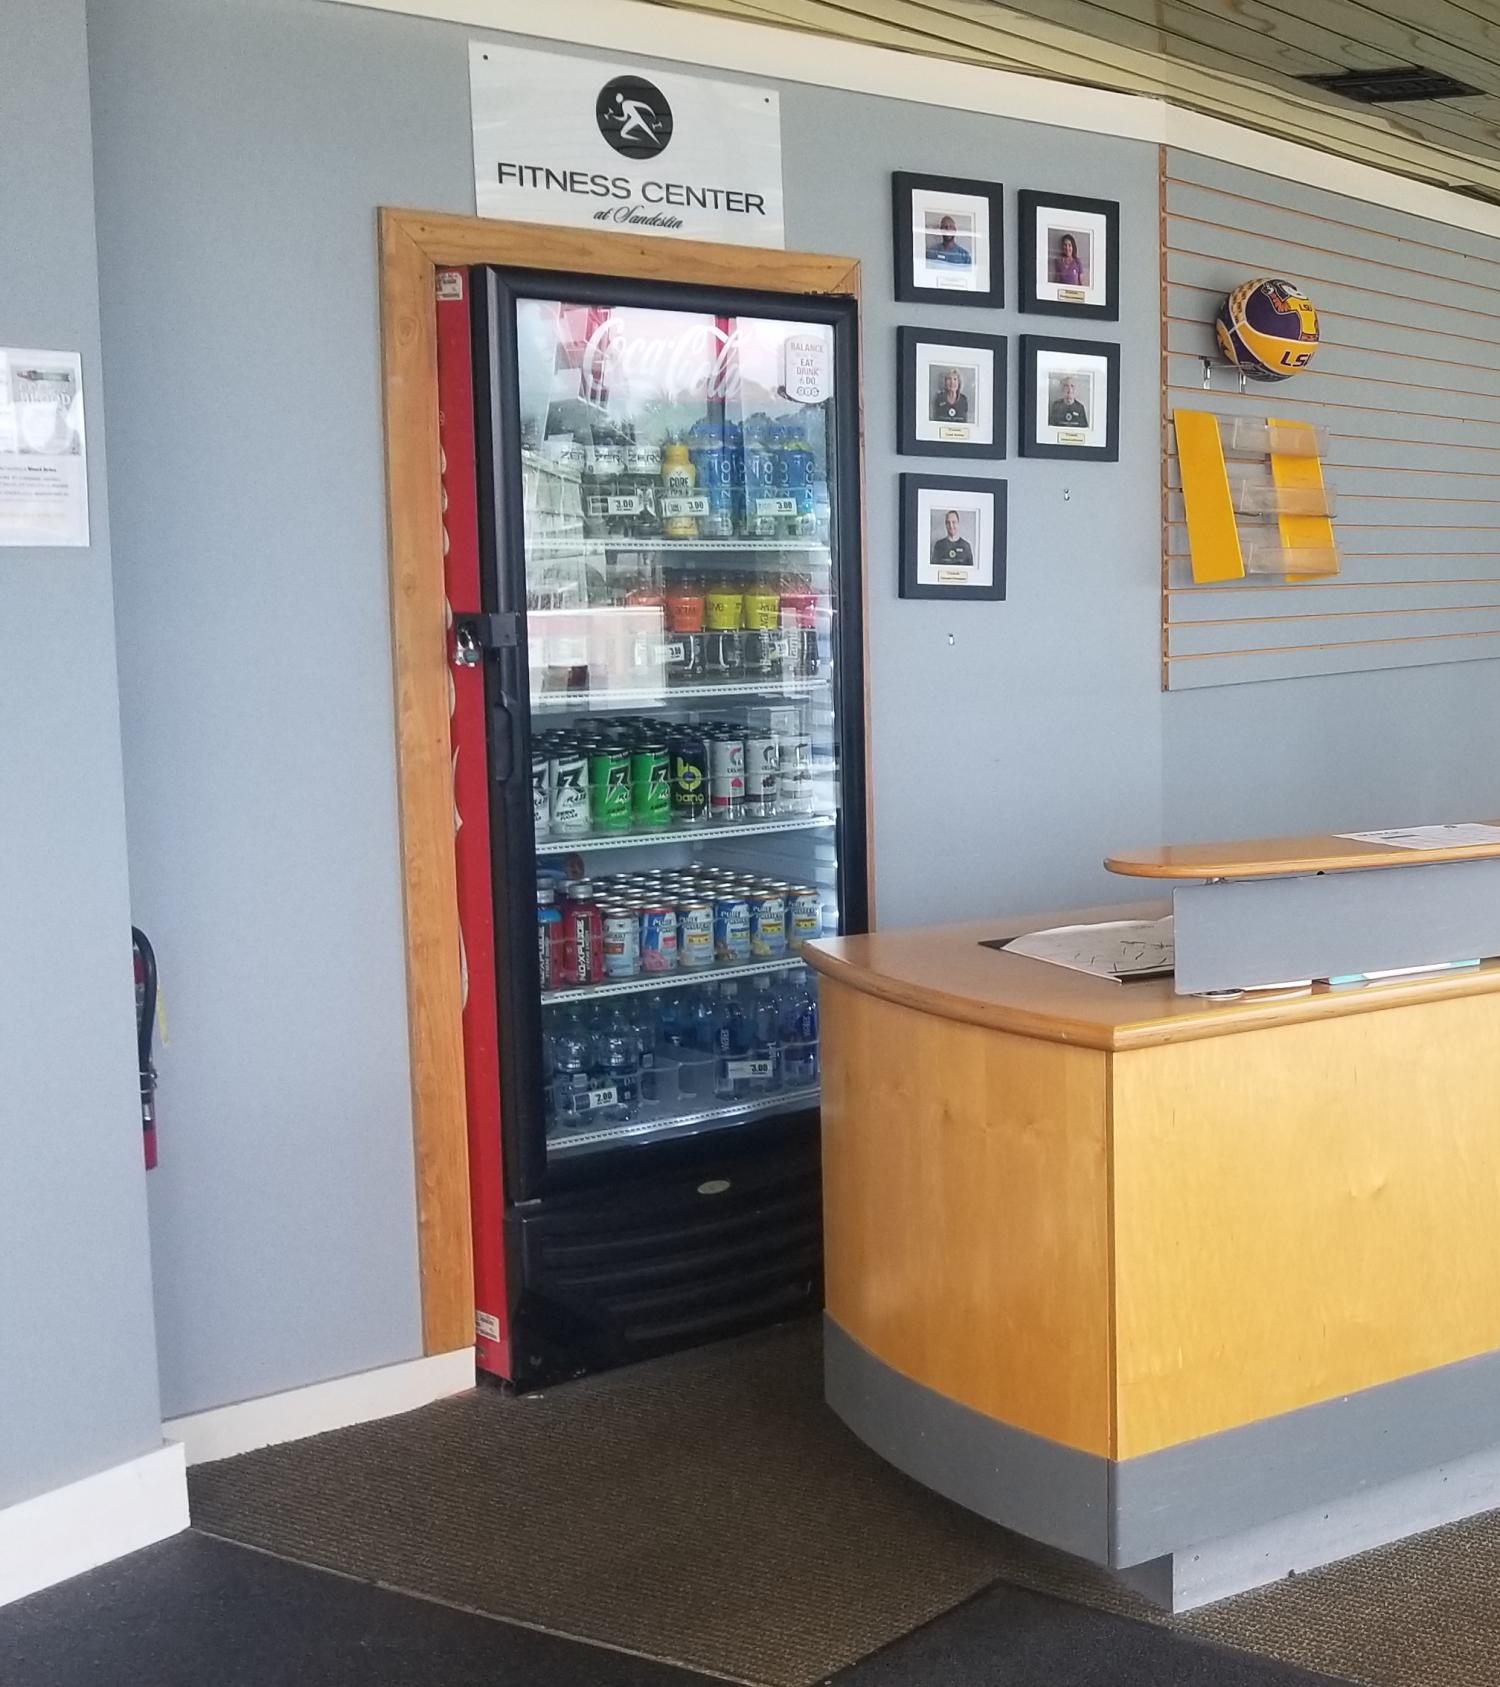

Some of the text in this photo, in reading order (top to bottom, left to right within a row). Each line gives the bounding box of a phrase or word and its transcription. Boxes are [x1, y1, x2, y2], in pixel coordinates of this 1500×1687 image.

[497, 162, 767, 215] FITNESS CENTER
[593, 204, 683, 230] at Sandestin
[790, 342, 824, 353] BALANCE
[796, 367, 819, 376] DRINK
[806, 377, 816, 385] DO
[670, 477, 689, 488] CORE
